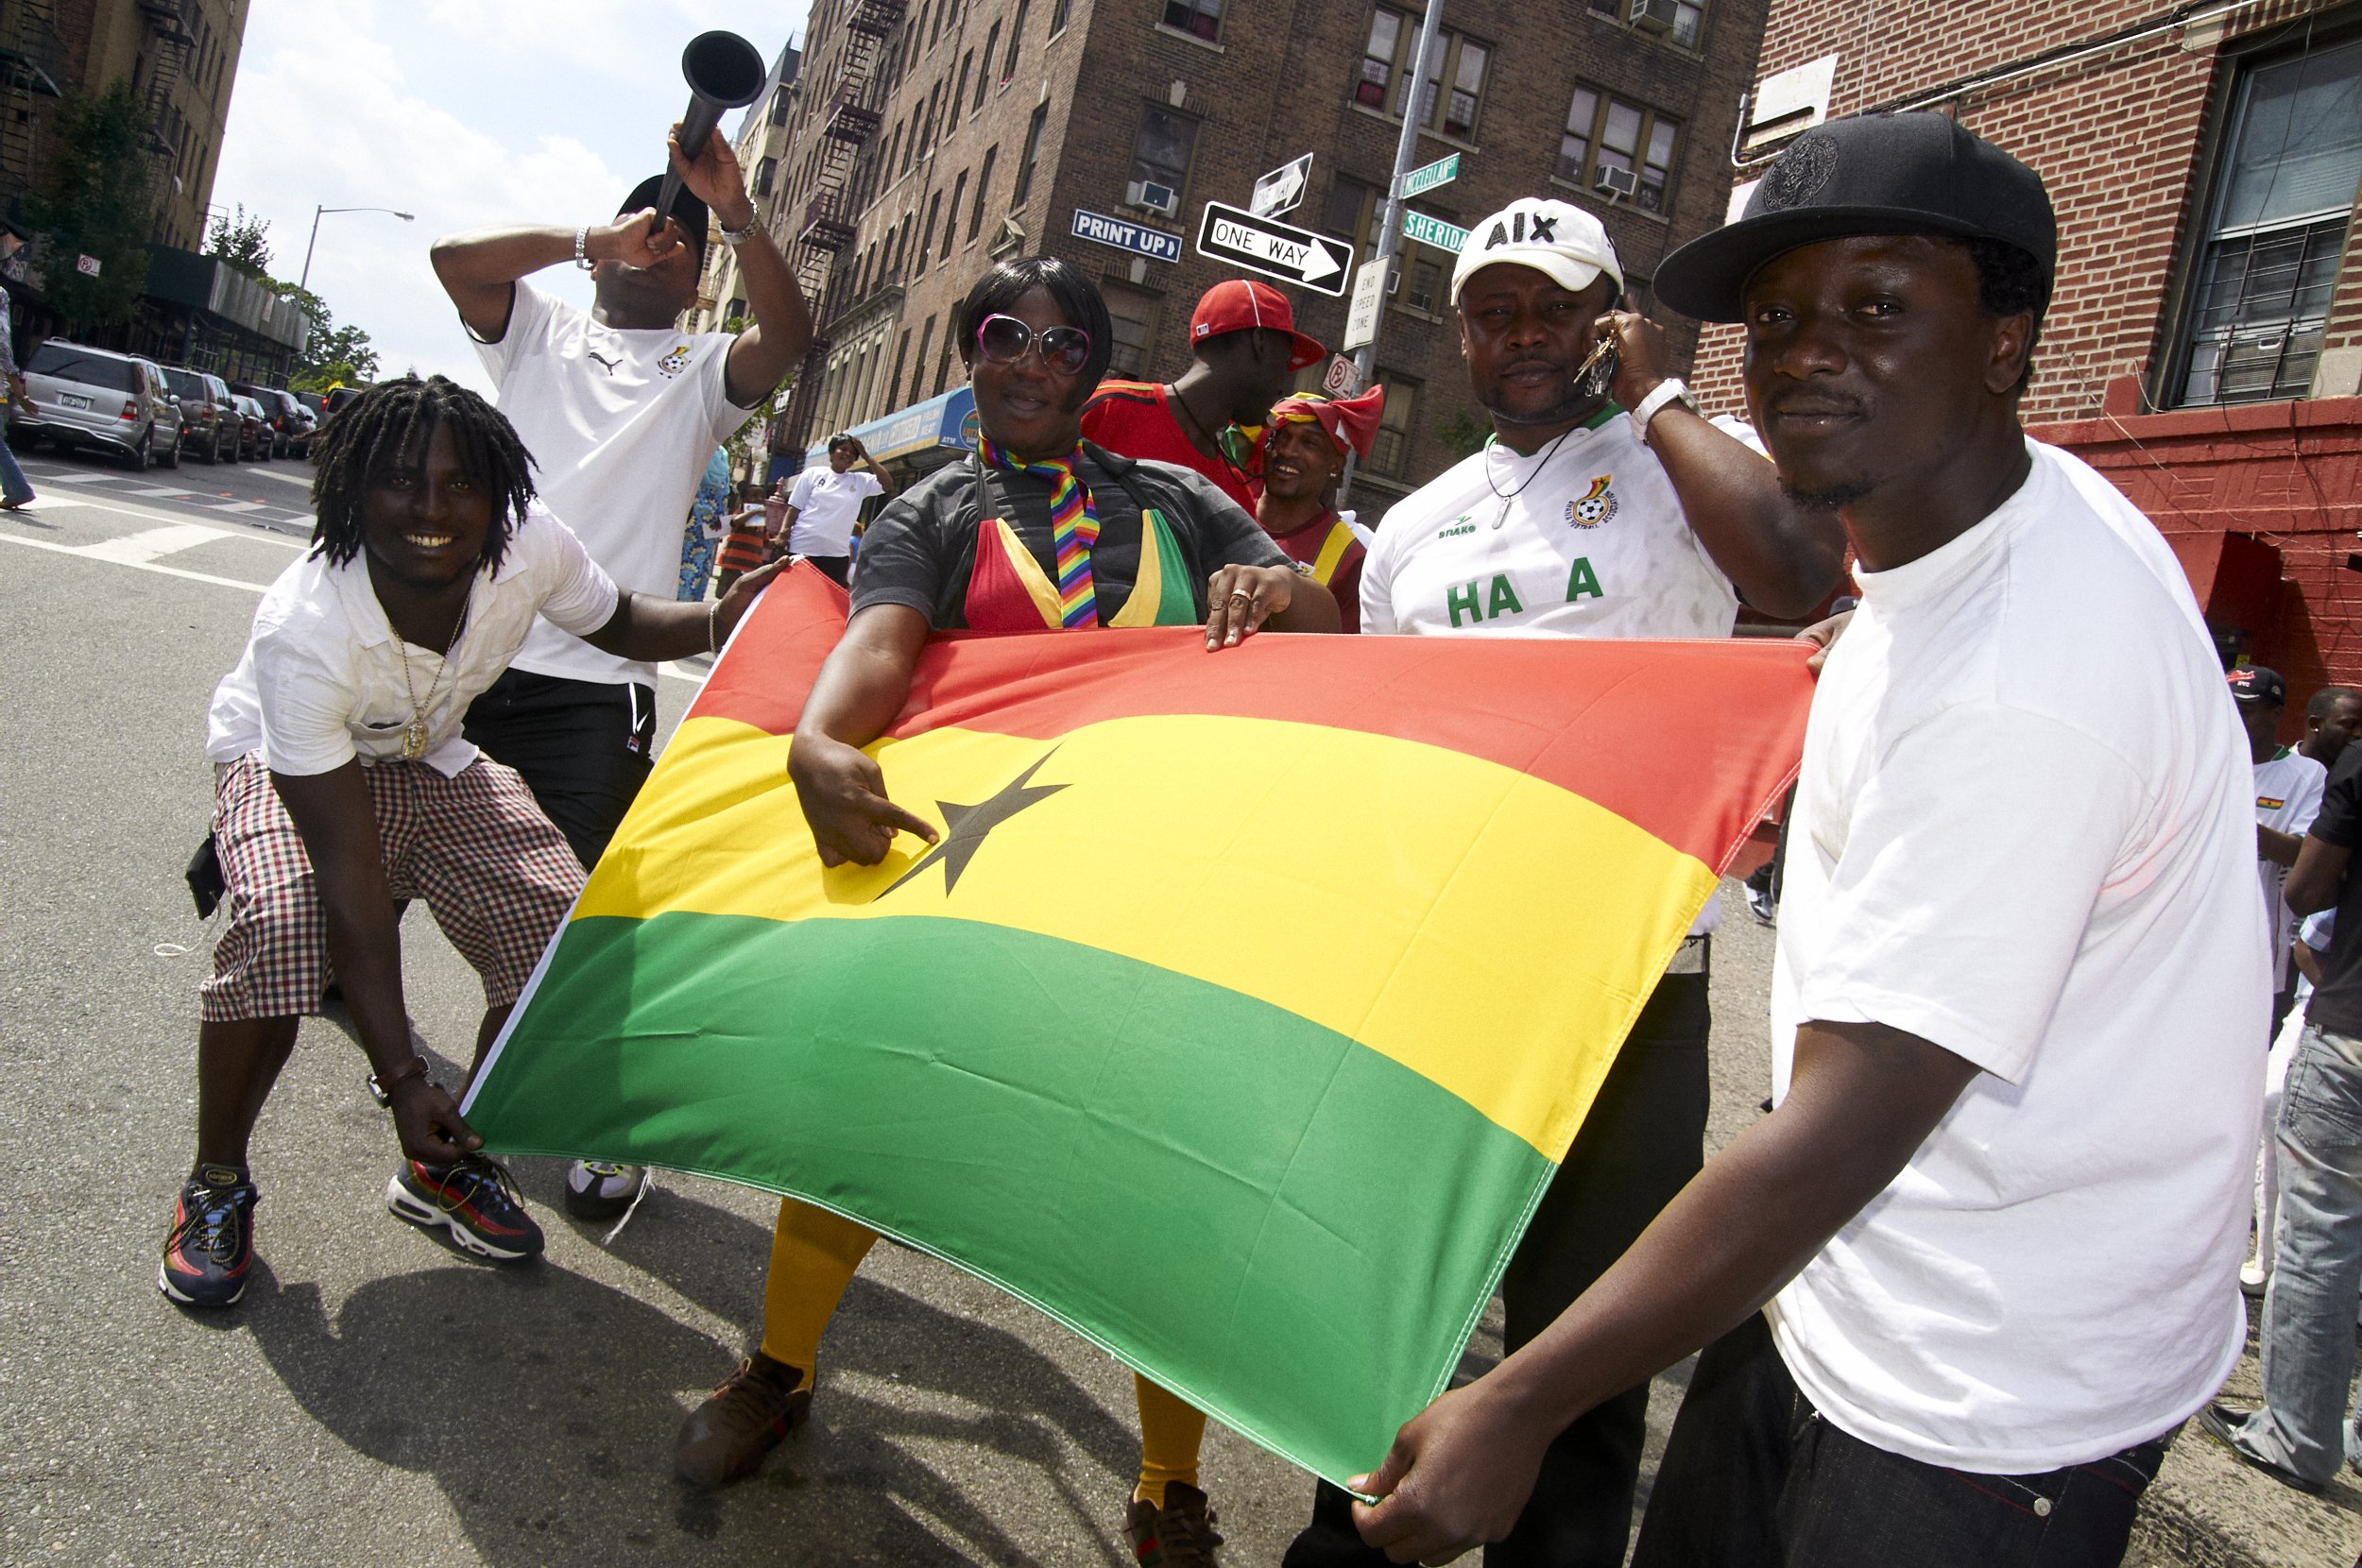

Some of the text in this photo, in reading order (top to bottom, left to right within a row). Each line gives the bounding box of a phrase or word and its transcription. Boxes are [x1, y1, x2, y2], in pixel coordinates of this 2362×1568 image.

[1256, 177, 1292, 210] ONE WAY
[1404, 157, 1457, 195] MCCLELLAN ST
[1077, 214, 1166, 254] PRINT UP
[1216, 223, 1309, 266] ONE WAY
[1484, 213, 1559, 250] AIX
[1354, 294, 1376, 313] SPEED
[1352, 315, 1370, 332] ZONE
